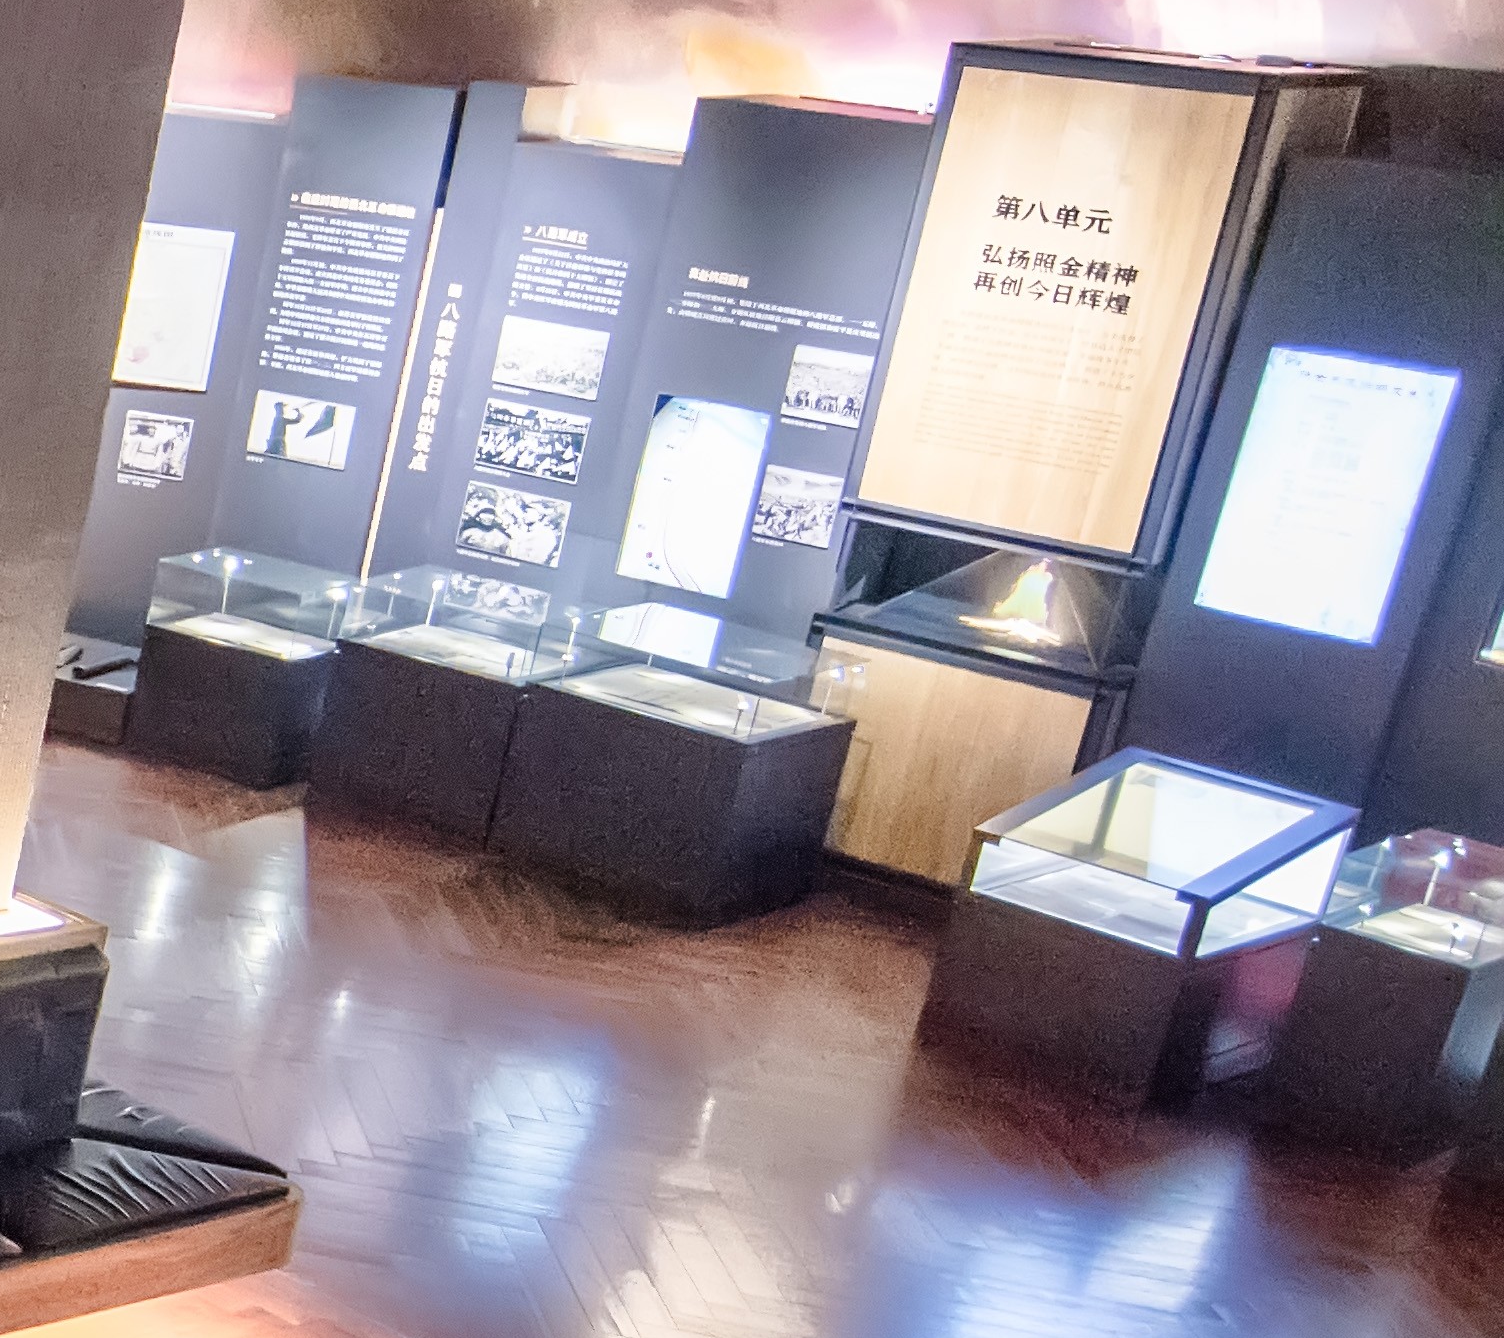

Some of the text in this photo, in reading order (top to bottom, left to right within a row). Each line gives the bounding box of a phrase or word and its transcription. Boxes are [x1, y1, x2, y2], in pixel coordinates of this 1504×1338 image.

[991, 194, 1114, 235] 第八单元
[981, 244, 1140, 288] 弘扬照金精神
[972, 271, 1133, 316] 再创今日辉煌
